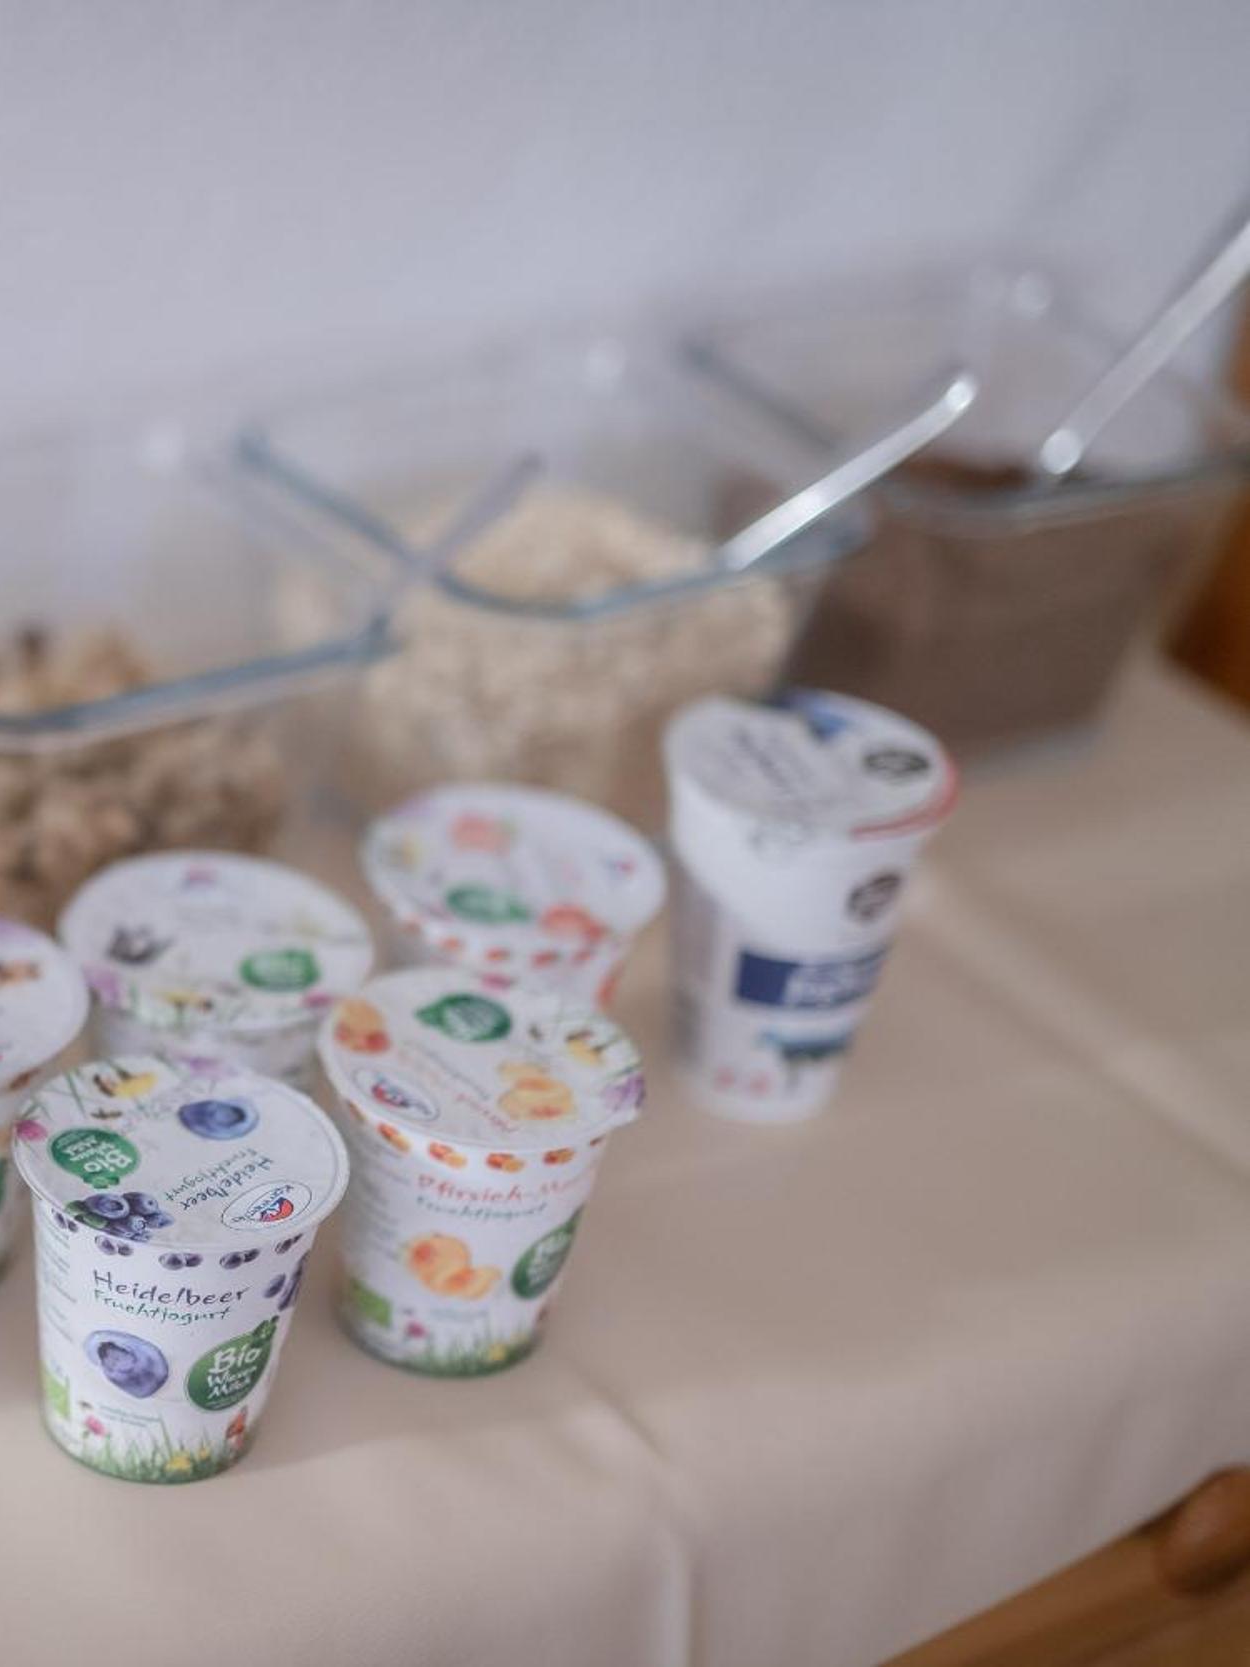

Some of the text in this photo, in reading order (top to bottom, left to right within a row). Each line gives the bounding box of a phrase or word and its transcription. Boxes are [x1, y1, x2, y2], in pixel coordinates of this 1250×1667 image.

[83, 1149, 133, 1173] Bio
[180, 1156, 274, 1211] Heidelbeer
[92, 1269, 252, 1307] Heidelbeer
[93, 1289, 231, 1327] Fruchtjogurt
[208, 1344, 262, 1374] Bio
